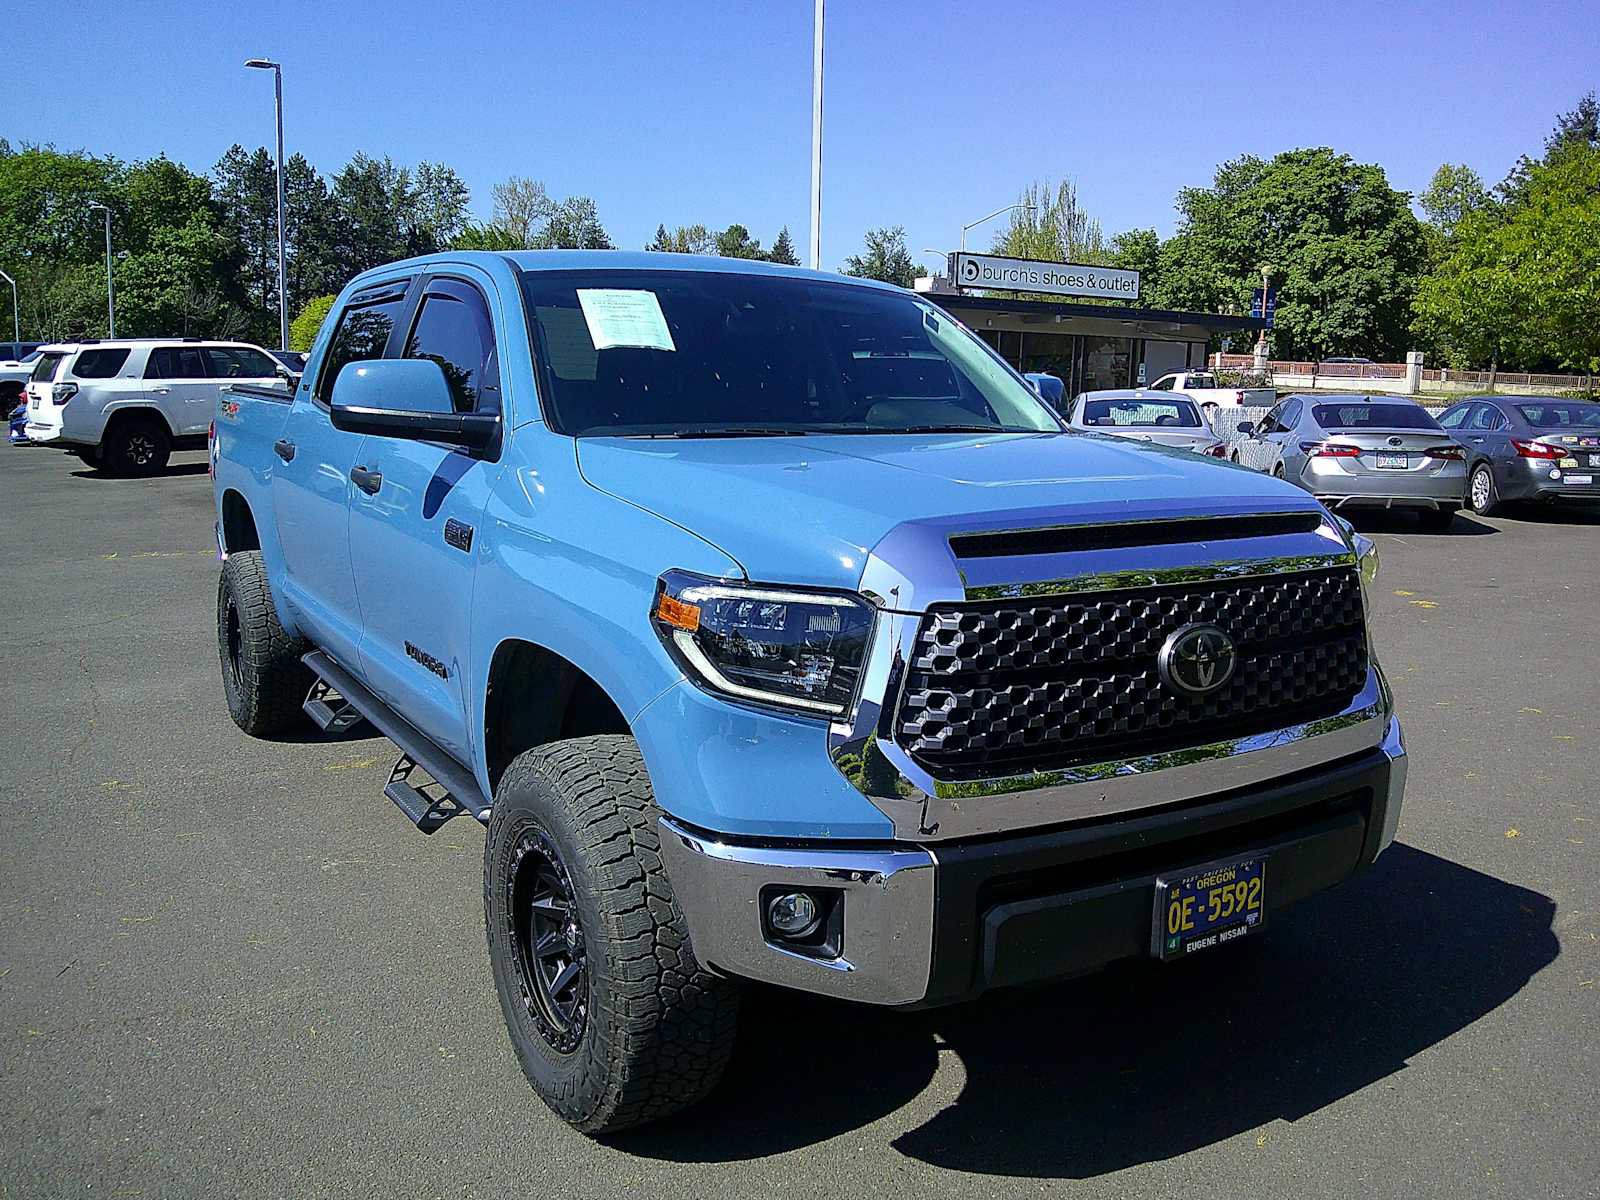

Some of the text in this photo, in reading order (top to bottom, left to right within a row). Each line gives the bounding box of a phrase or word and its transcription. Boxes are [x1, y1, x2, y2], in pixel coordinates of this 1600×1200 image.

[1043, 270, 1084, 288] shoes
[1086, 274, 1096, 289] &
[1099, 277, 1136, 293] outlet
[1196, 870, 1236, 890] OREGON
[1186, 925, 1248, 953] EUGENE NISSAN
